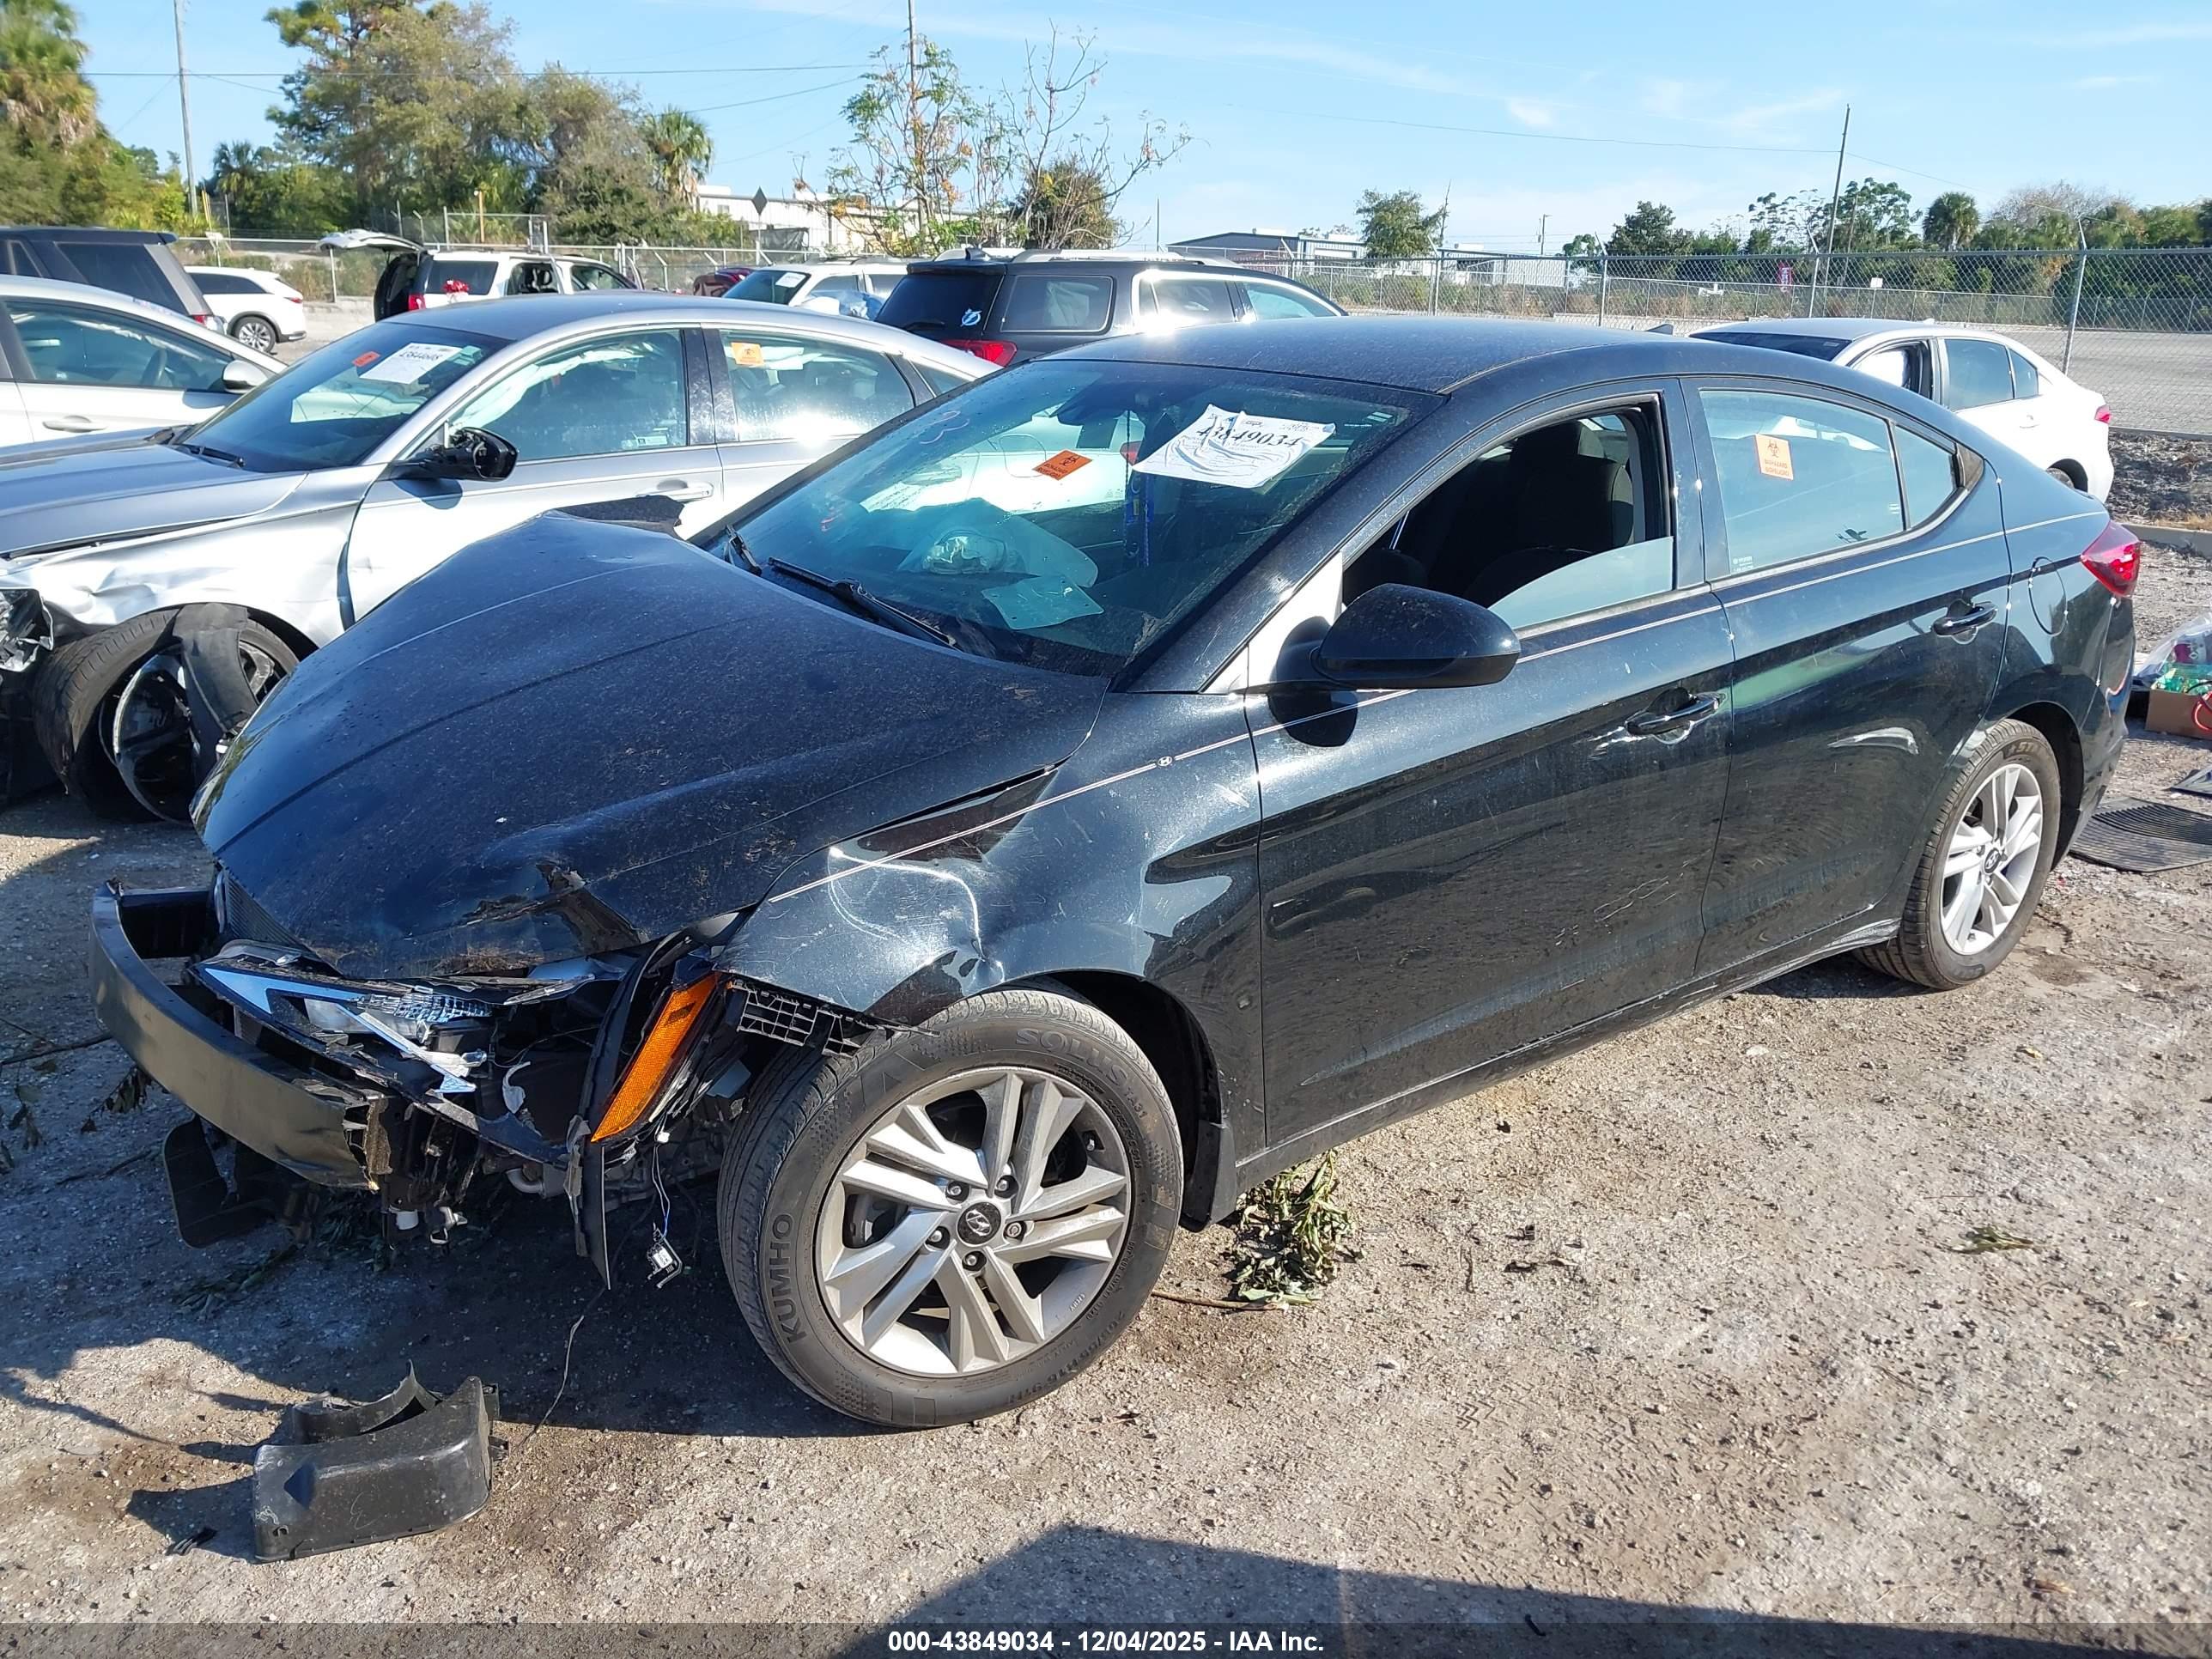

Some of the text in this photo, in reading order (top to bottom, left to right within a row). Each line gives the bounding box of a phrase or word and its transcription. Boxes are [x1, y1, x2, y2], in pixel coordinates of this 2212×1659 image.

[1016, 1028, 1127, 1087] SOLUS
[1123, 1088, 1147, 1119] TA31
[769, 1213, 807, 1343] KUMHO
